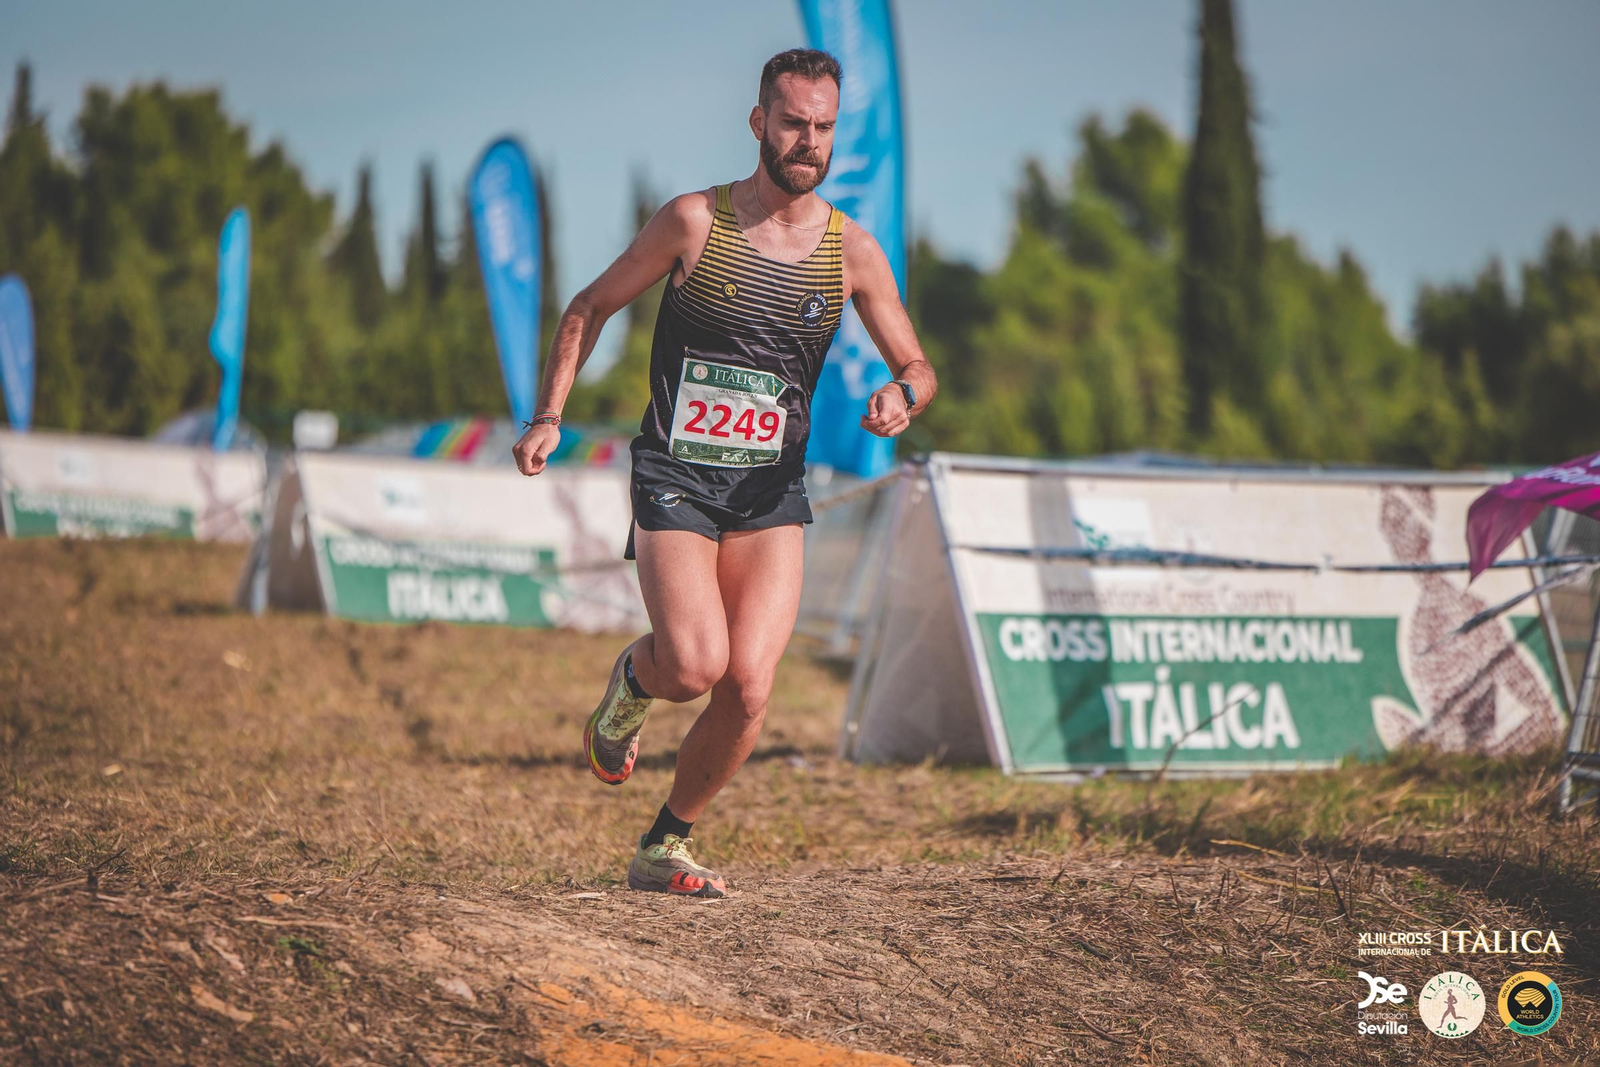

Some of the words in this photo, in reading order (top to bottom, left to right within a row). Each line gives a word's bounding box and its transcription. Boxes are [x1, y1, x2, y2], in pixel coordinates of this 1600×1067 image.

[714, 369, 764, 387] ITÁLICA
[683, 400, 779, 442] 2249
[999, 617, 1108, 662] CROSS
[1109, 618, 1364, 664] INTERNACIONAL
[1102, 664, 1301, 750] ITÁLICA
